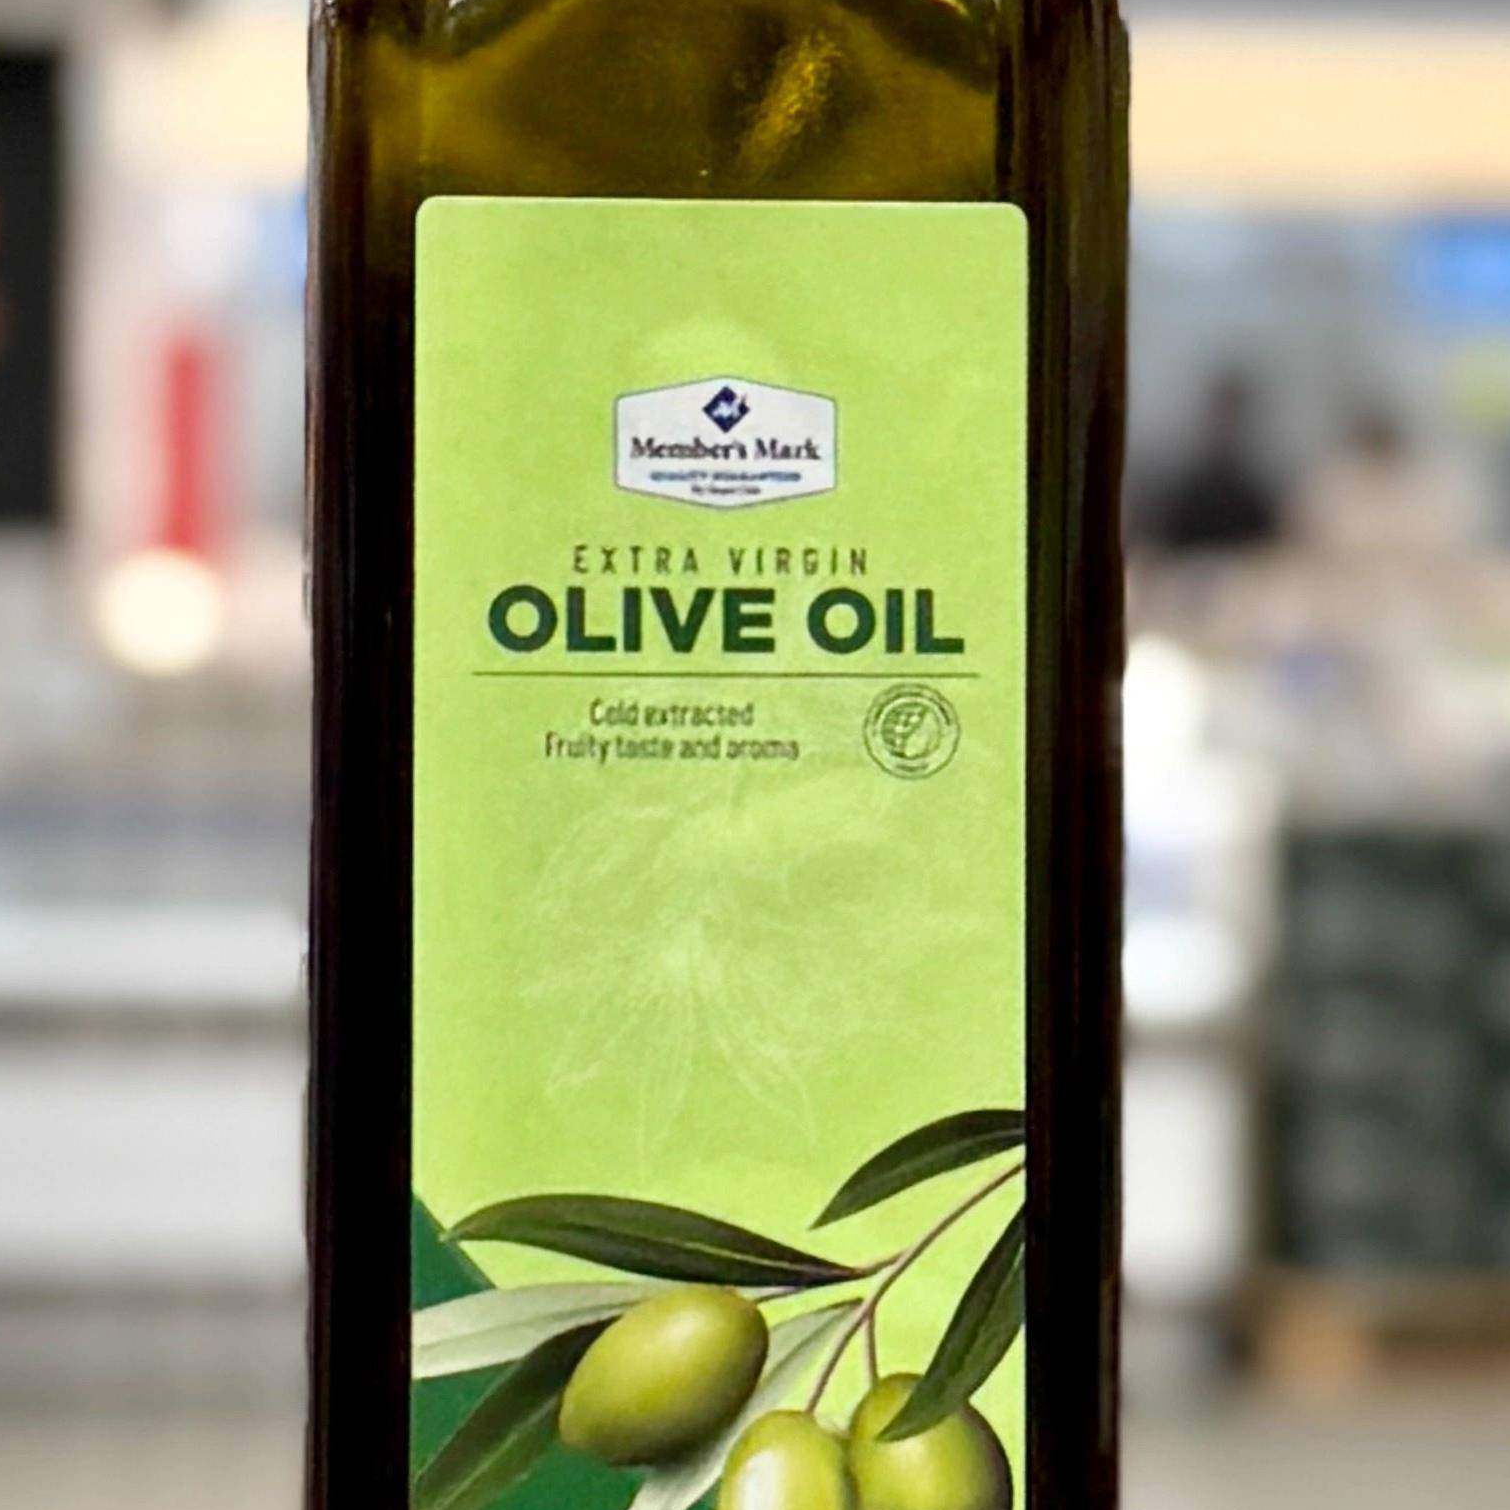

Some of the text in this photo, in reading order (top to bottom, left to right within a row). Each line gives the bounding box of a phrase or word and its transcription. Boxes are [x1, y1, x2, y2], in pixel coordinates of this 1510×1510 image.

[631, 436, 820, 460] Member's Mark
[573, 544, 867, 576] EXTRA VIRGIN
[488, 584, 965, 655] OLIVE OIL
[591, 697, 754, 727] Cold extracted
[545, 731, 799, 765] Fruity taste and aroma
